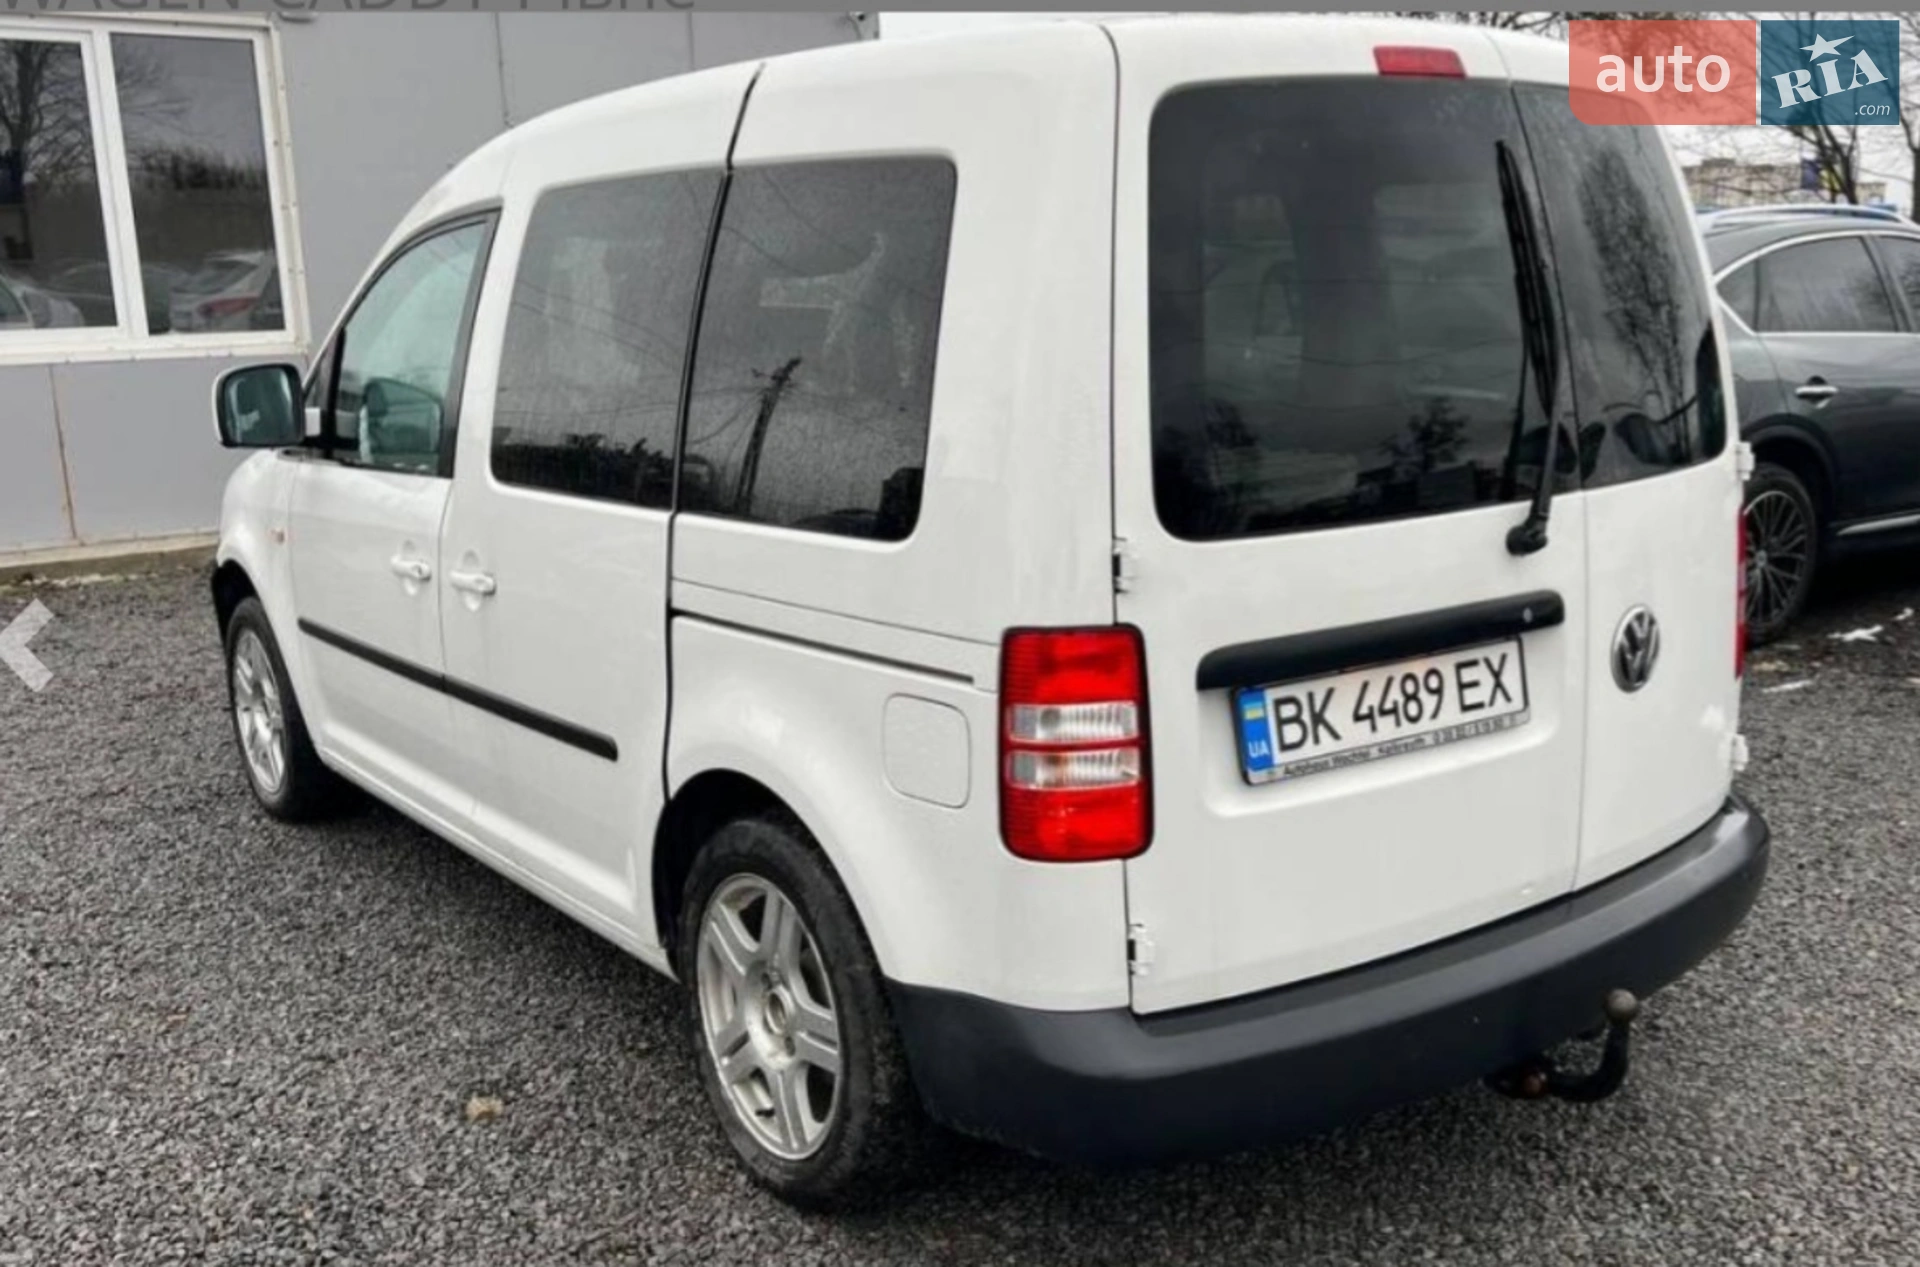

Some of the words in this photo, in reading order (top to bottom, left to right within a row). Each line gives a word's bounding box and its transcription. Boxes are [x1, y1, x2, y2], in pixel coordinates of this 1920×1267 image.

[1273, 687, 1342, 752] BK
[1352, 667, 1446, 734] 4489
[1454, 653, 1513, 714] EX
[1248, 739, 1270, 759] UA
